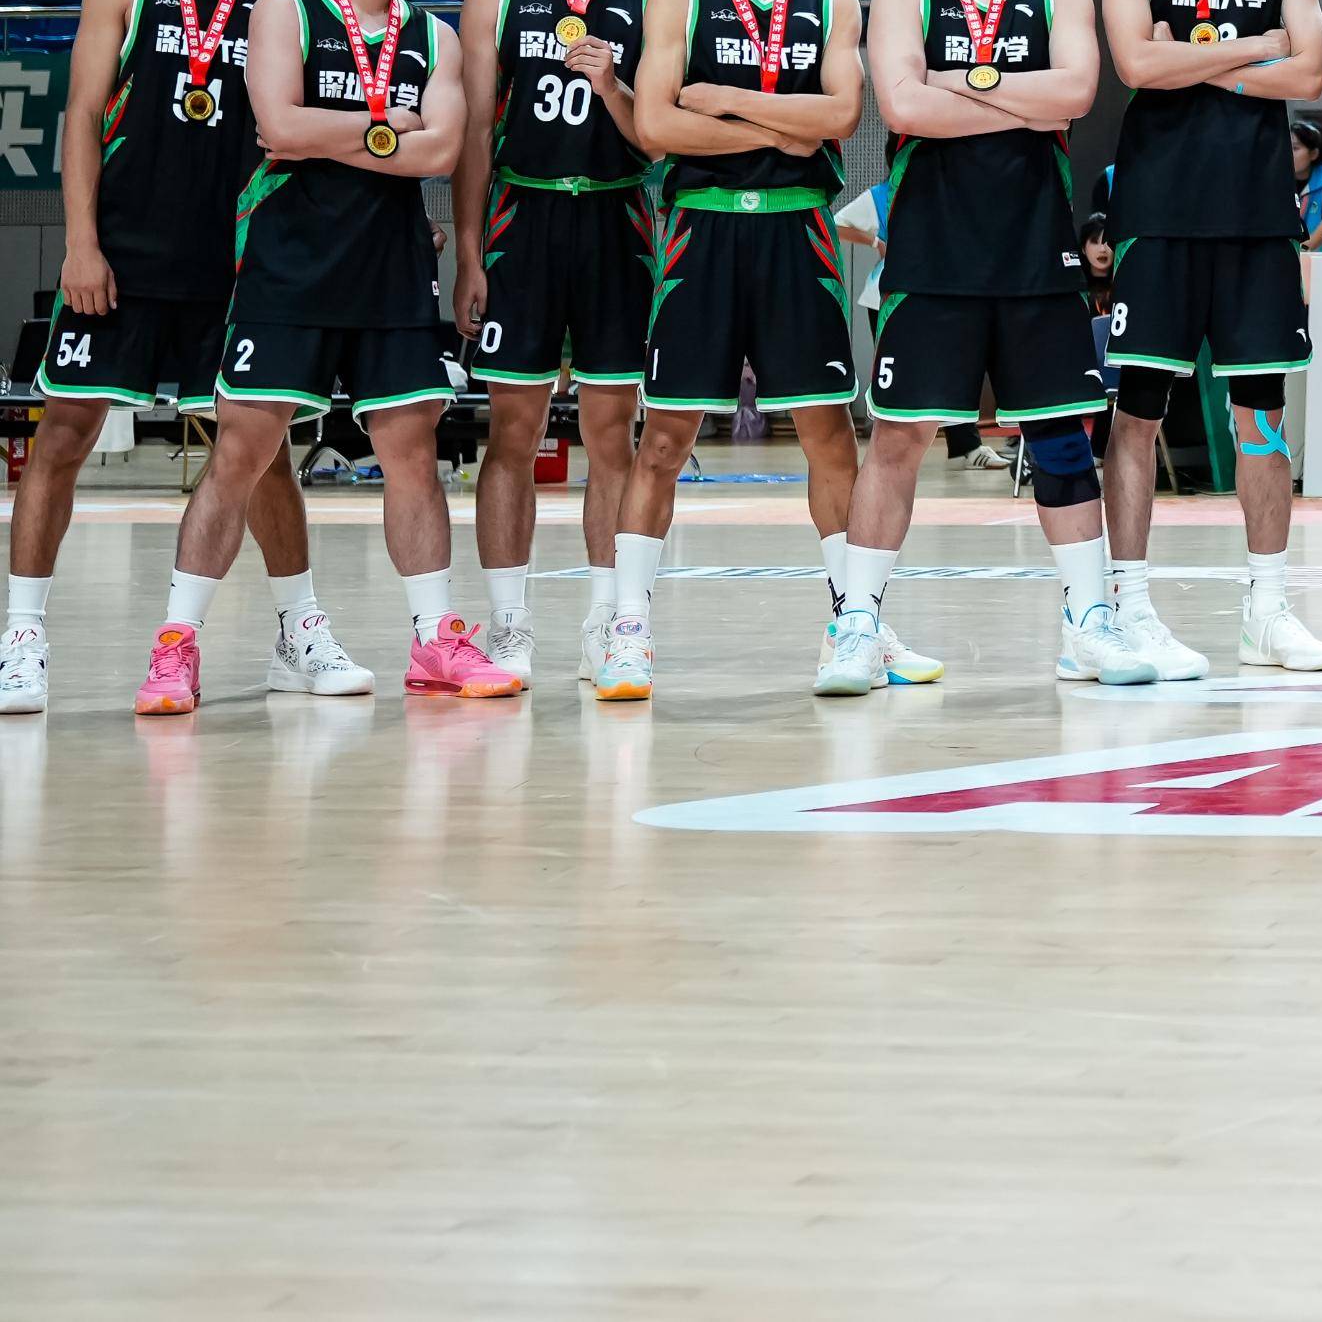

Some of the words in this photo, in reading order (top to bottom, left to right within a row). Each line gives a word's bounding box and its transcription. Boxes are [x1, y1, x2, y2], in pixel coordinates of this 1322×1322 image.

[155, 24, 248, 66] 深大学
[519, 30, 625, 65] 深圳学
[533, 74, 592, 126] 30
[1110, 302, 1129, 337] 8
[57, 332, 92, 368] 54
[233, 338, 255, 372] 2
[878, 357, 895, 389] 5
